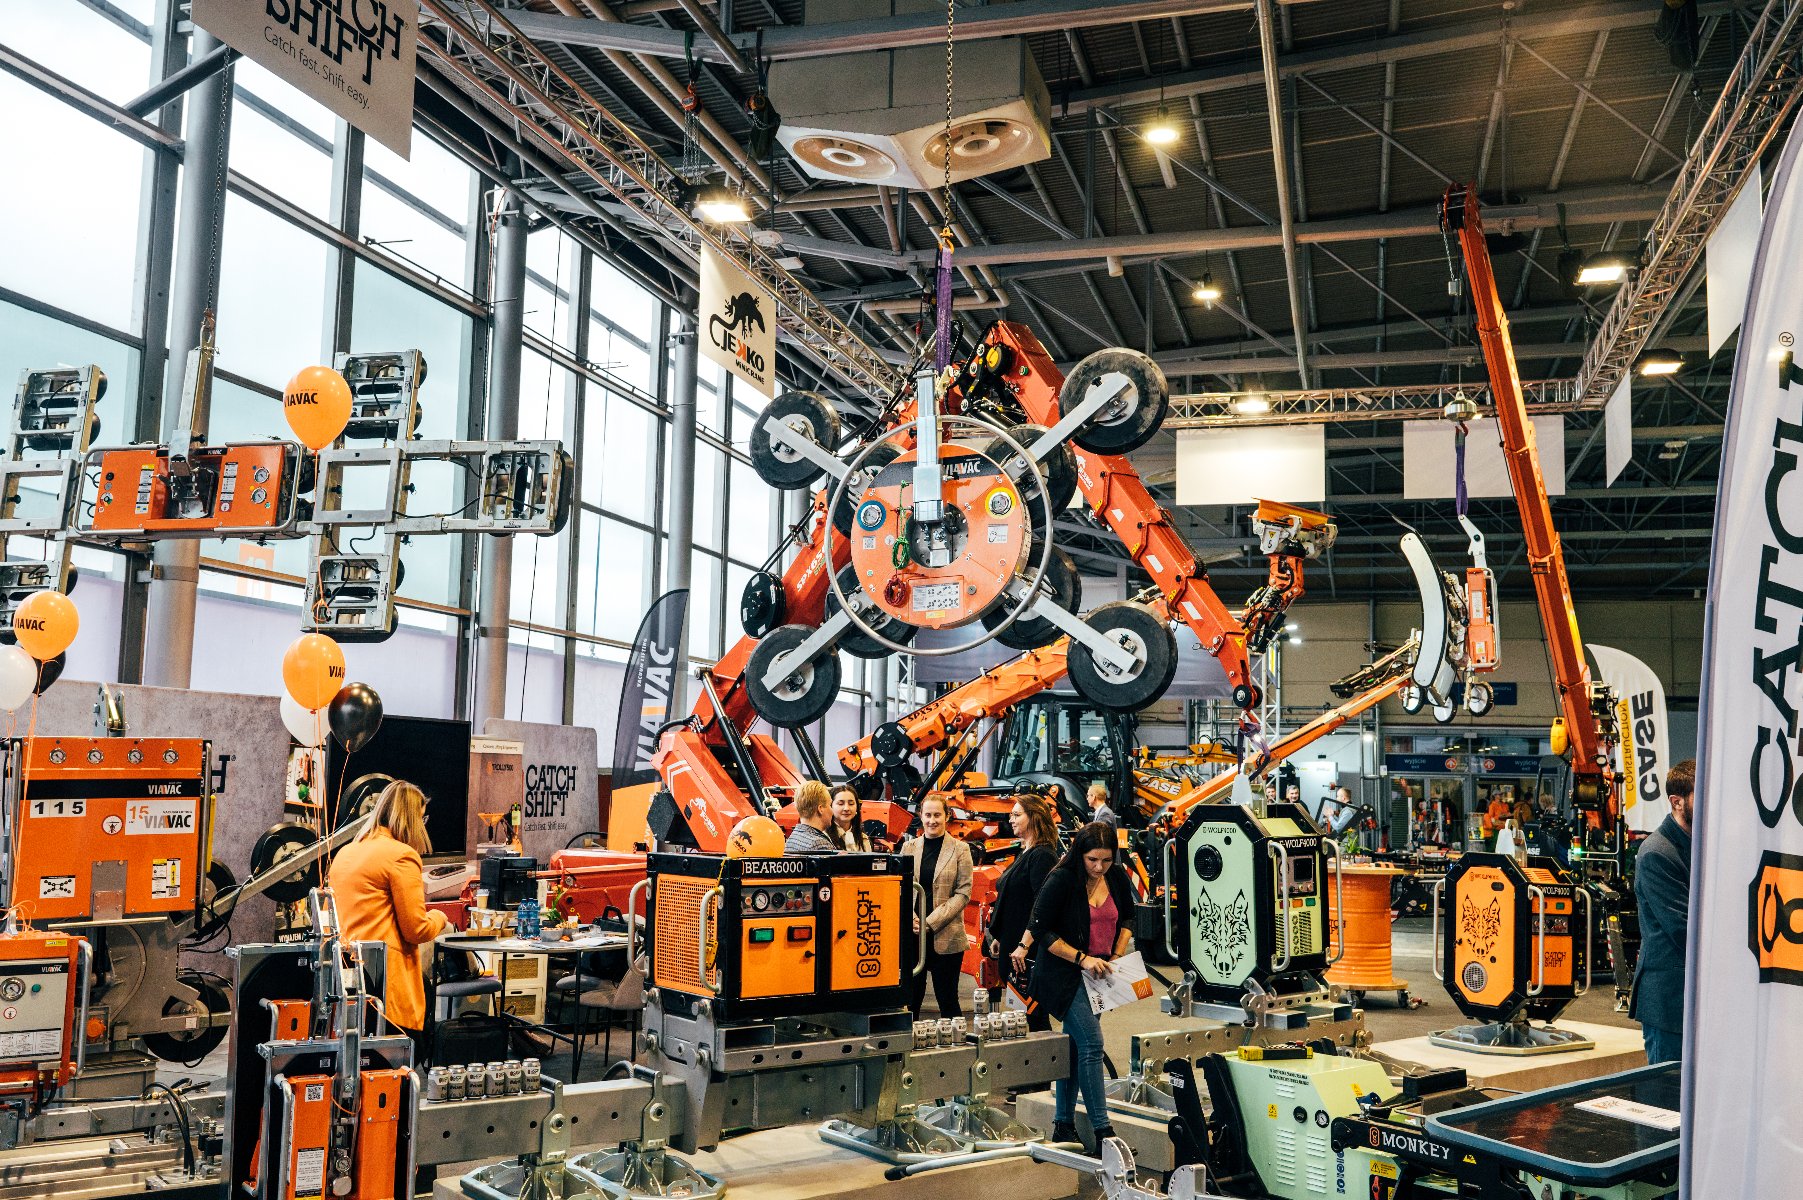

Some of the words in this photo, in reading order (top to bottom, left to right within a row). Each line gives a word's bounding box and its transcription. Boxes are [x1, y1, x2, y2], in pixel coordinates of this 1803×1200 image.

[264, 26, 296, 59] Catch
[299, 48, 320, 75] fast.
[322, 65, 346, 92] Shift
[347, 86, 370, 109] easy.
[148, 784, 182, 795] VIAVAC
[525, 764, 577, 791] CATCH
[1138, 776, 1182, 796] CASE
[524, 791, 568, 818] SHIFT
[144, 814, 192, 829] VIAVAC
[1526, 847, 1541, 856] ASE
[744, 861, 803, 874] BEAR6000
[856, 889, 869, 956] CATCH
[868, 900, 881, 956] SHIFT
[1382, 1131, 1450, 1160] MONKEY
